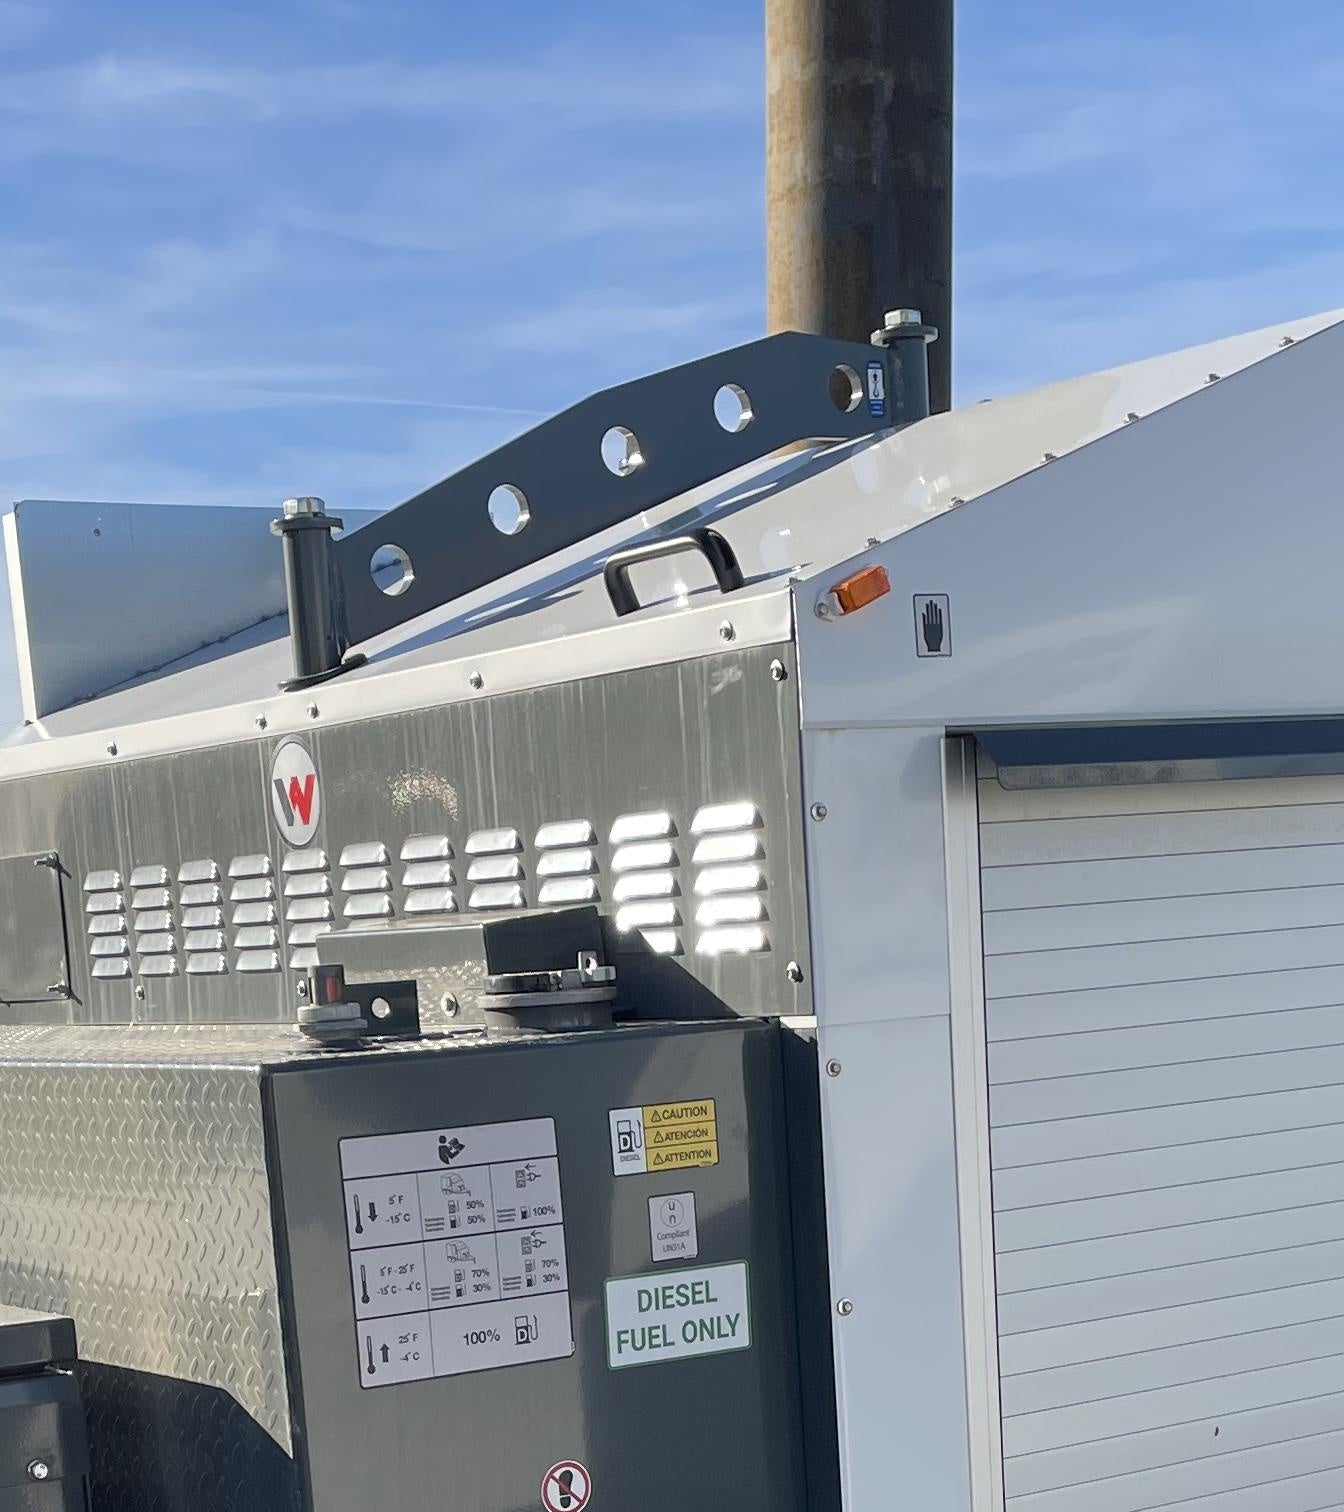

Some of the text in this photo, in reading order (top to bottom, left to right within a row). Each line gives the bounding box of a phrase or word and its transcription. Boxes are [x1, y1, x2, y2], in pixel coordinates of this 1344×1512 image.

[662, 1105, 708, 1120] CAUTION
[665, 1148, 712, 1162] ATTENTION
[466, 1199, 485, 1210] 50%
[533, 1205, 556, 1216] 100%
[468, 1214, 486, 1225] 50%
[541, 1259, 560, 1269] 70%
[472, 1268, 490, 1279] 70%
[543, 1273, 561, 1284] 30%
[473, 1283, 492, 1293] 30%
[637, 1280, 718, 1313] DIESEL
[463, 1328, 501, 1346] 100%
[617, 1313, 740, 1354] FUEL ONLY
